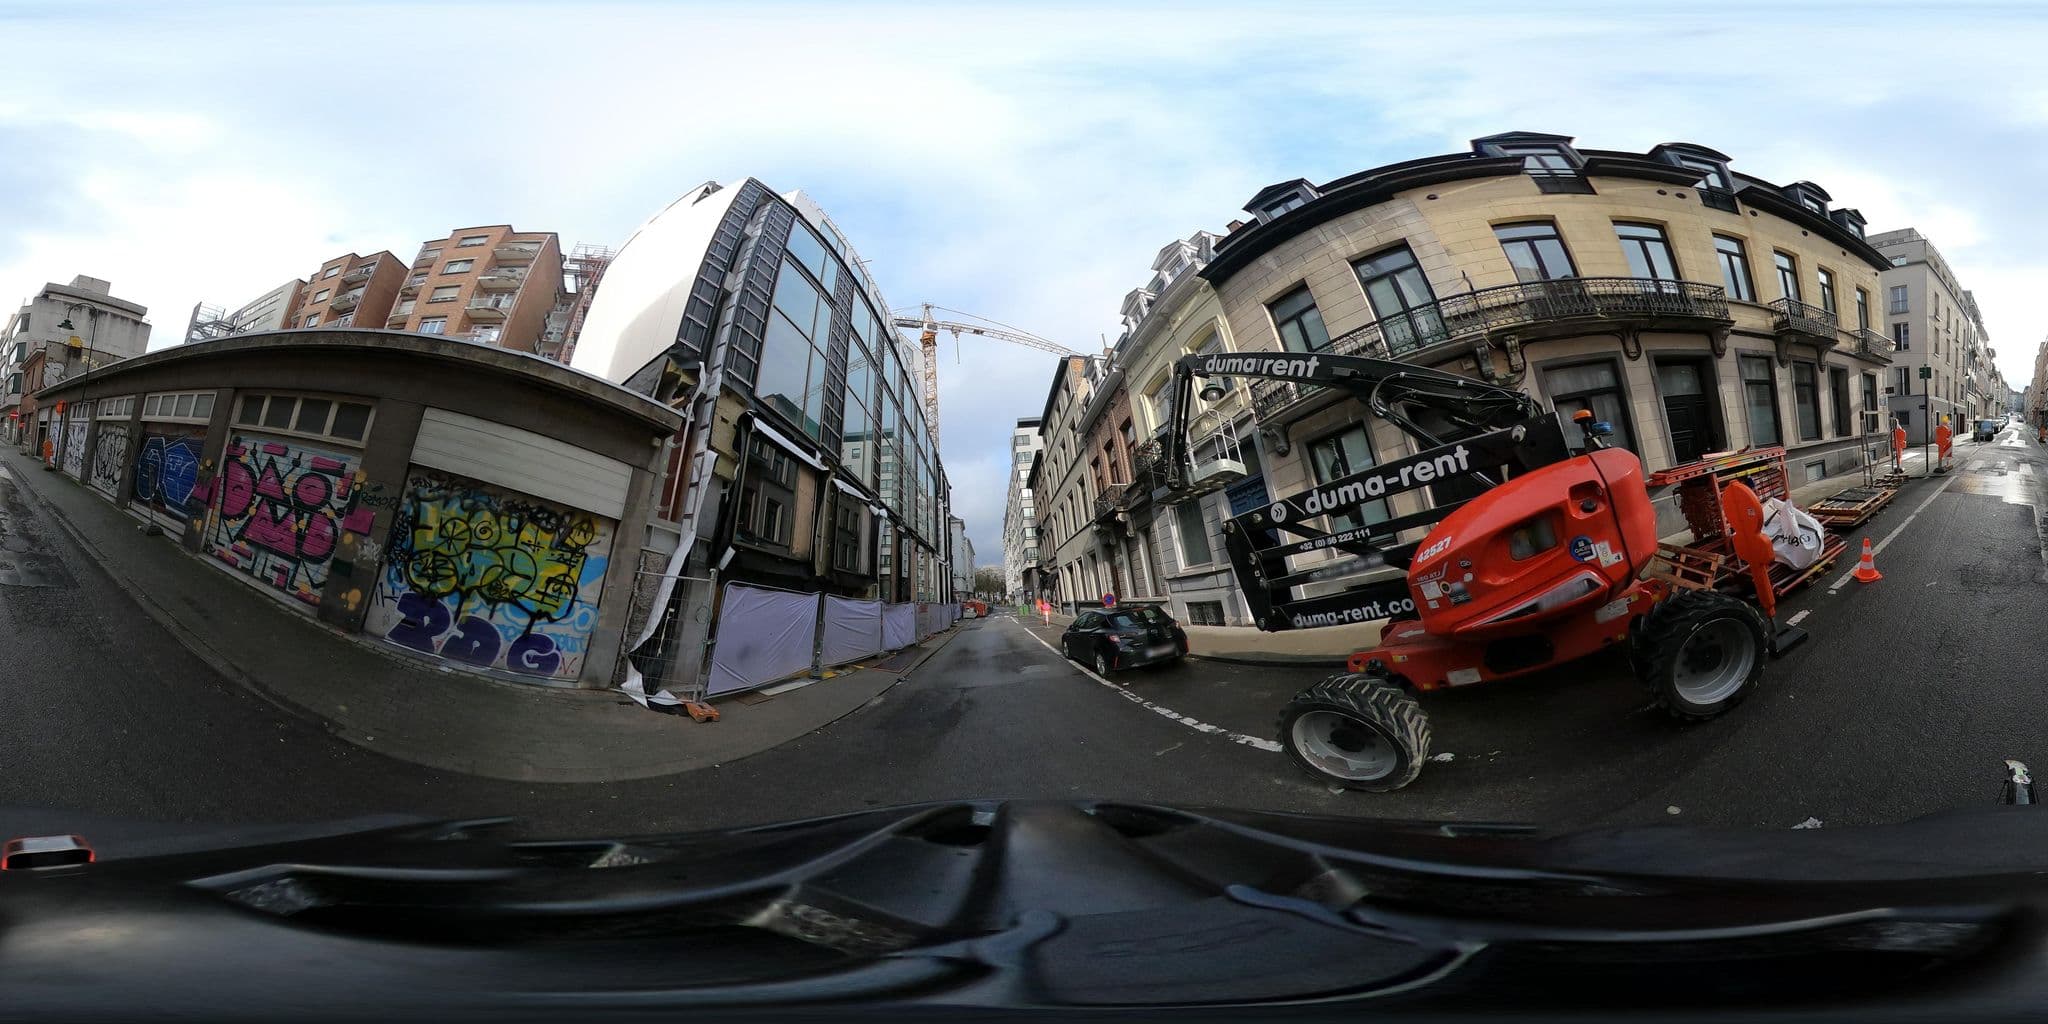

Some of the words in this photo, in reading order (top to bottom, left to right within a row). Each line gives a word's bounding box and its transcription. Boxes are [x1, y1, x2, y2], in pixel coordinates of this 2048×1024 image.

[1205, 355, 1320, 377] dumarent
[1304, 444, 1470, 514] duma-rent
[1337, 532, 1354, 543] 222
[1355, 527, 1371, 539] 111
[1416, 535, 1452, 564] 42527
[1293, 598, 1415, 627] duma-rent.co
